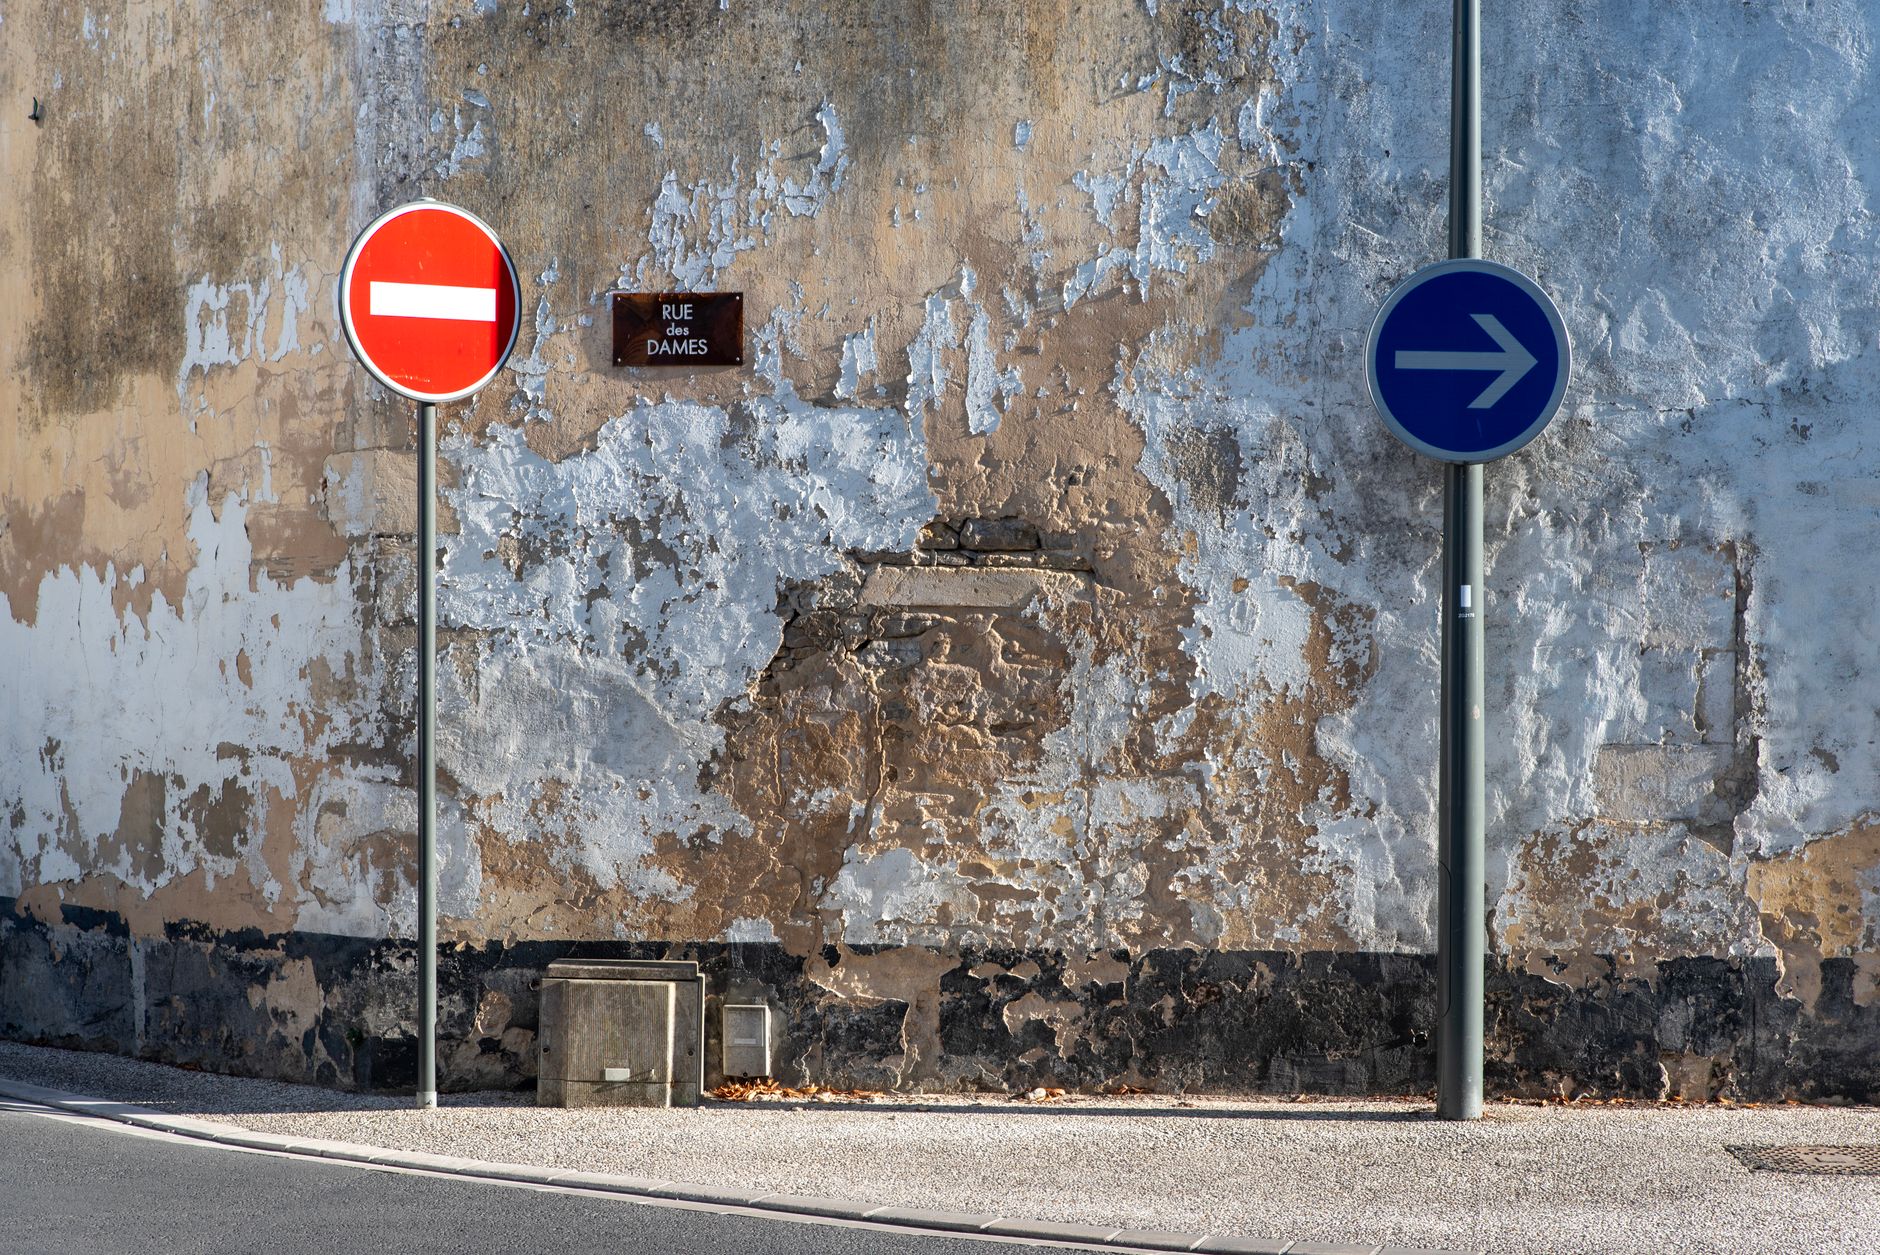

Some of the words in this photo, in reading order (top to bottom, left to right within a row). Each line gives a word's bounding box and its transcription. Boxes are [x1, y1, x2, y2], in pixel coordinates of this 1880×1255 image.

[662, 304, 693, 320] RUE
[666, 322, 690, 336] des
[647, 339, 708, 355] DAMES
